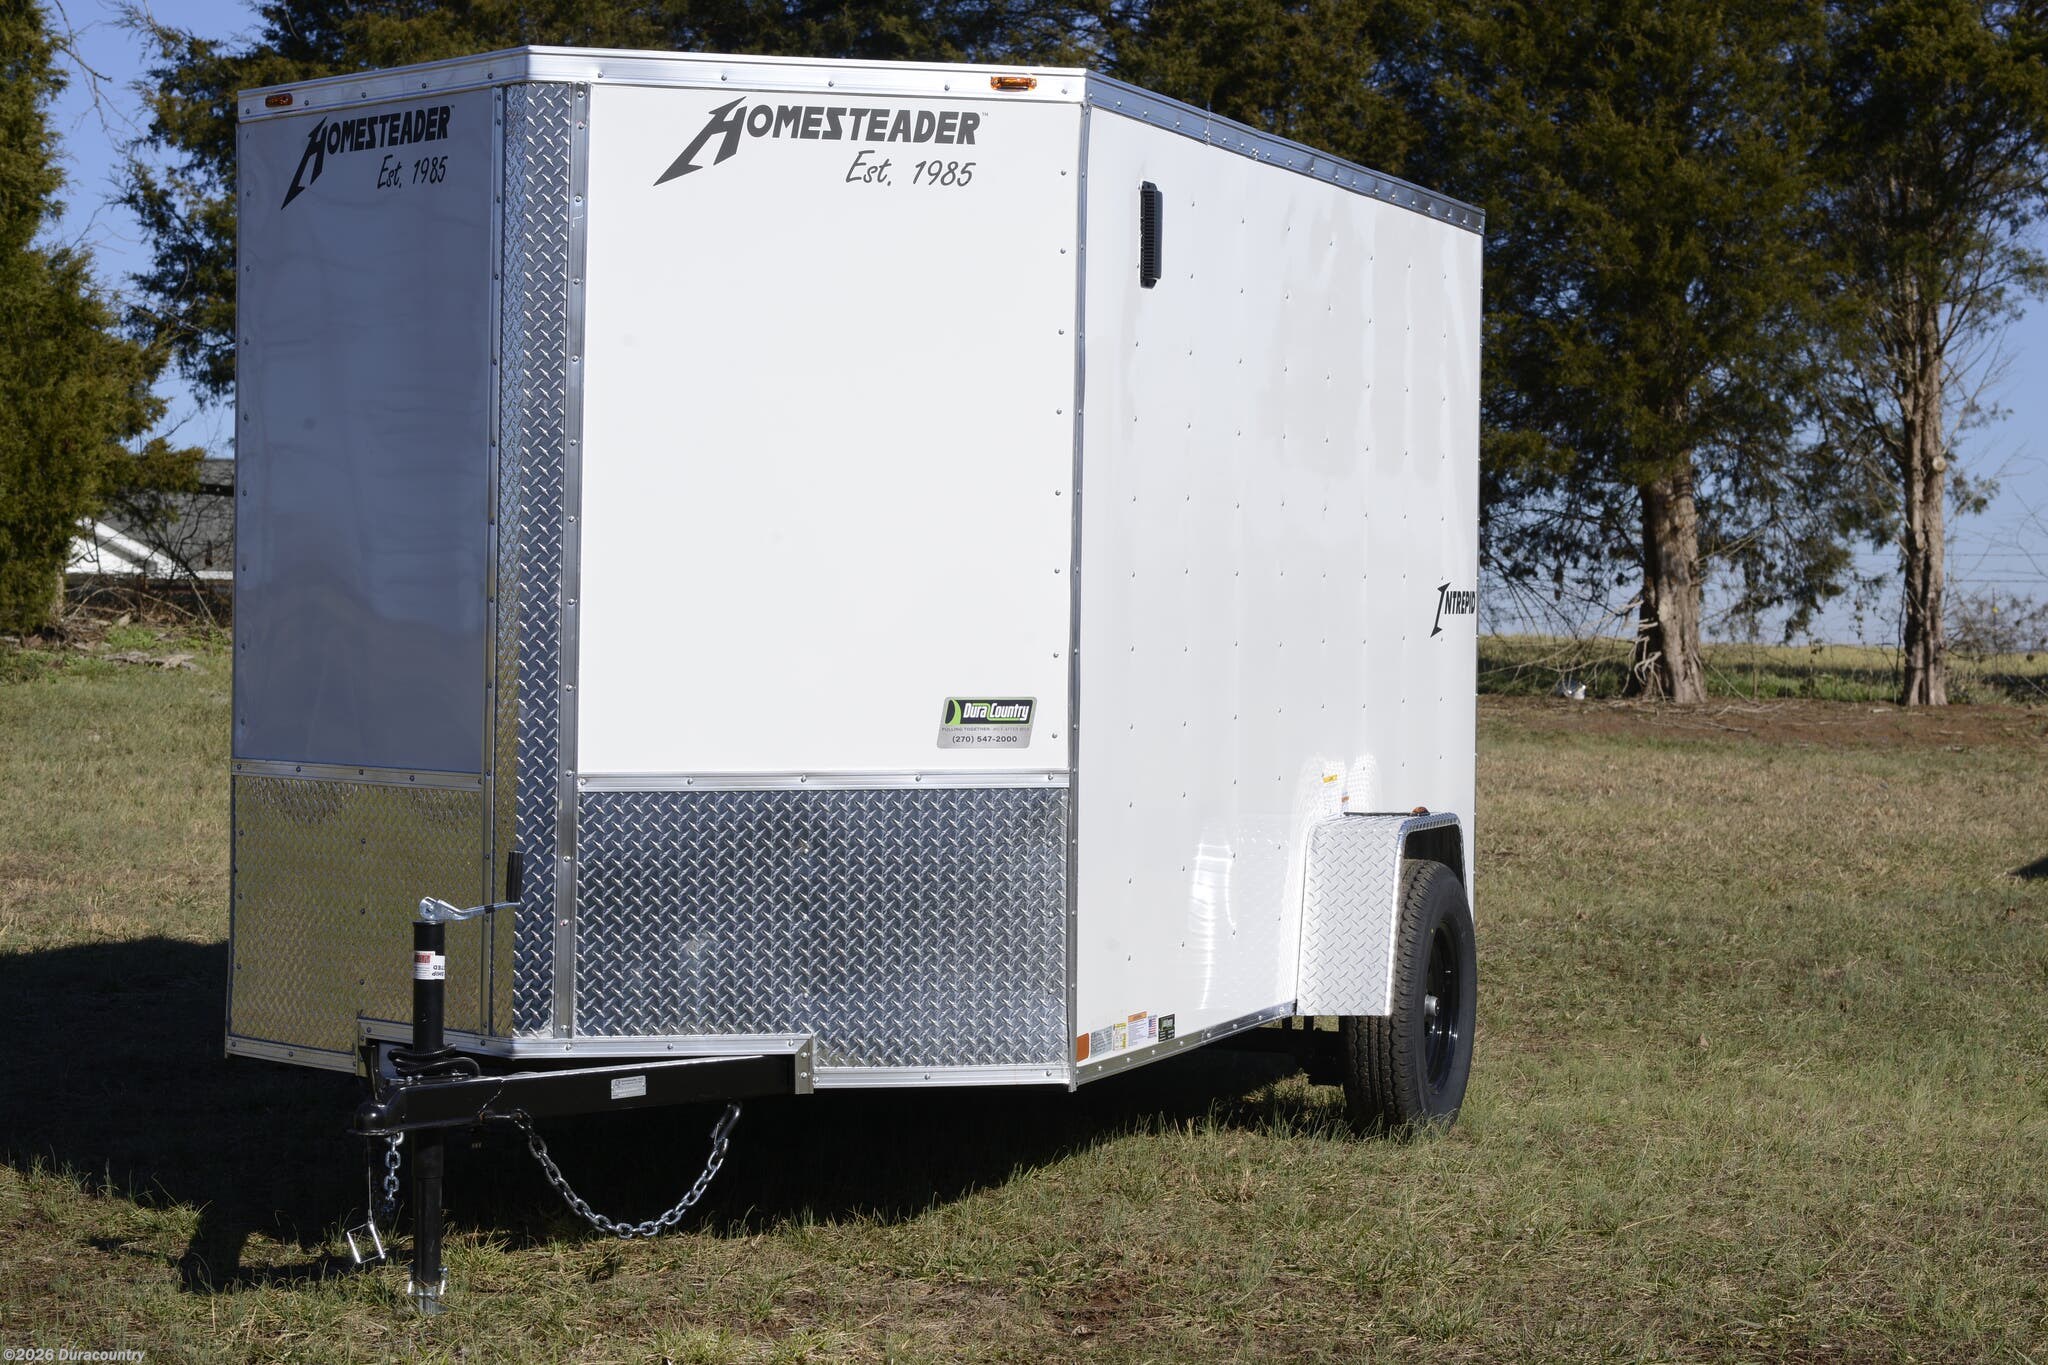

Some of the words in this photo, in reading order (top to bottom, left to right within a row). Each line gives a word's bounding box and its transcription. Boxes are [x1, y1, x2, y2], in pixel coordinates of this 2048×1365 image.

[653, 96, 981, 187] HOMESTEADER
[281, 105, 451, 210] HOMESTEADER
[412, 155, 448, 185] 1985
[912, 160, 976, 187] 1985
[1430, 582, 1476, 638] INTREPID
[963, 702, 988, 718] Dura
[989, 702, 1030, 721] Country
[952, 735, 974, 744] (270)
[977, 735, 1018, 743] 547-2000
